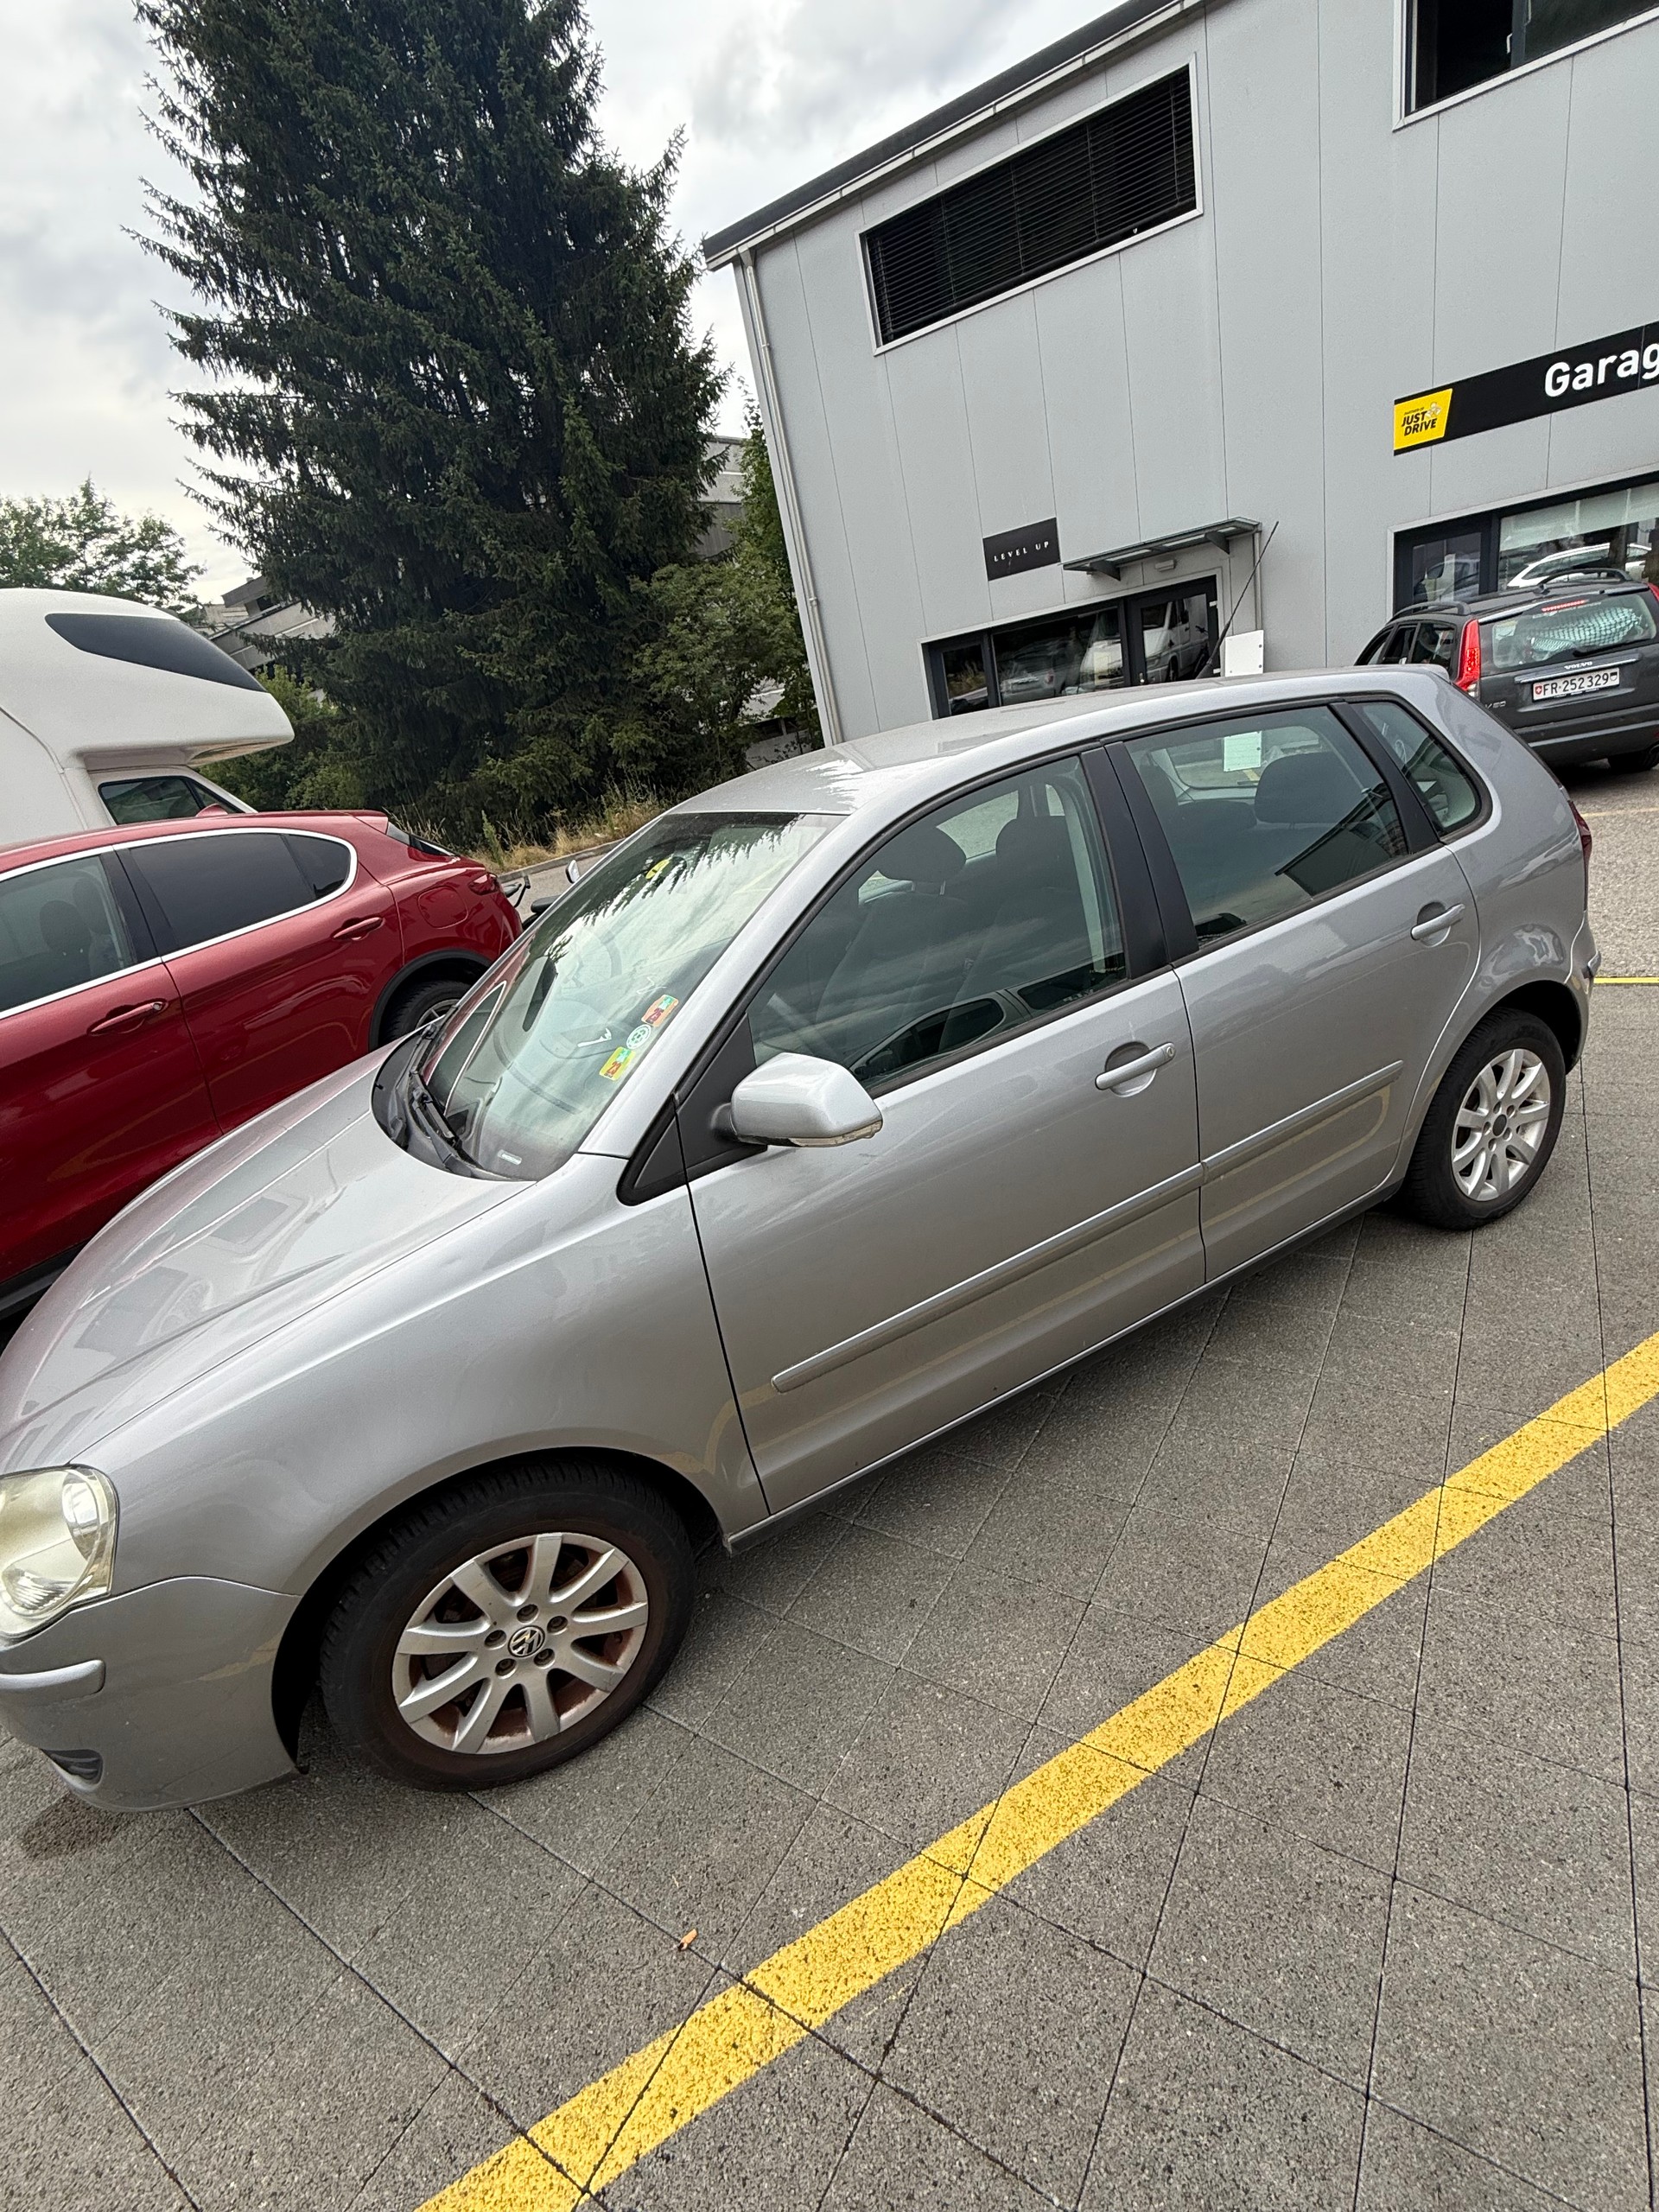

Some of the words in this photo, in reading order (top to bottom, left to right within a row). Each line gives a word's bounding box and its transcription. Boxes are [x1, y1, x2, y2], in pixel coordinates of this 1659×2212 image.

[1545, 343, 1659, 397] Garag
[1402, 410, 1427, 428] JUST
[1404, 418, 1438, 436] DRIVE
[994, 547, 1027, 562] LEVEL
[1035, 541, 1049, 550] UP
[1564, 661, 1592, 670] VOLVO
